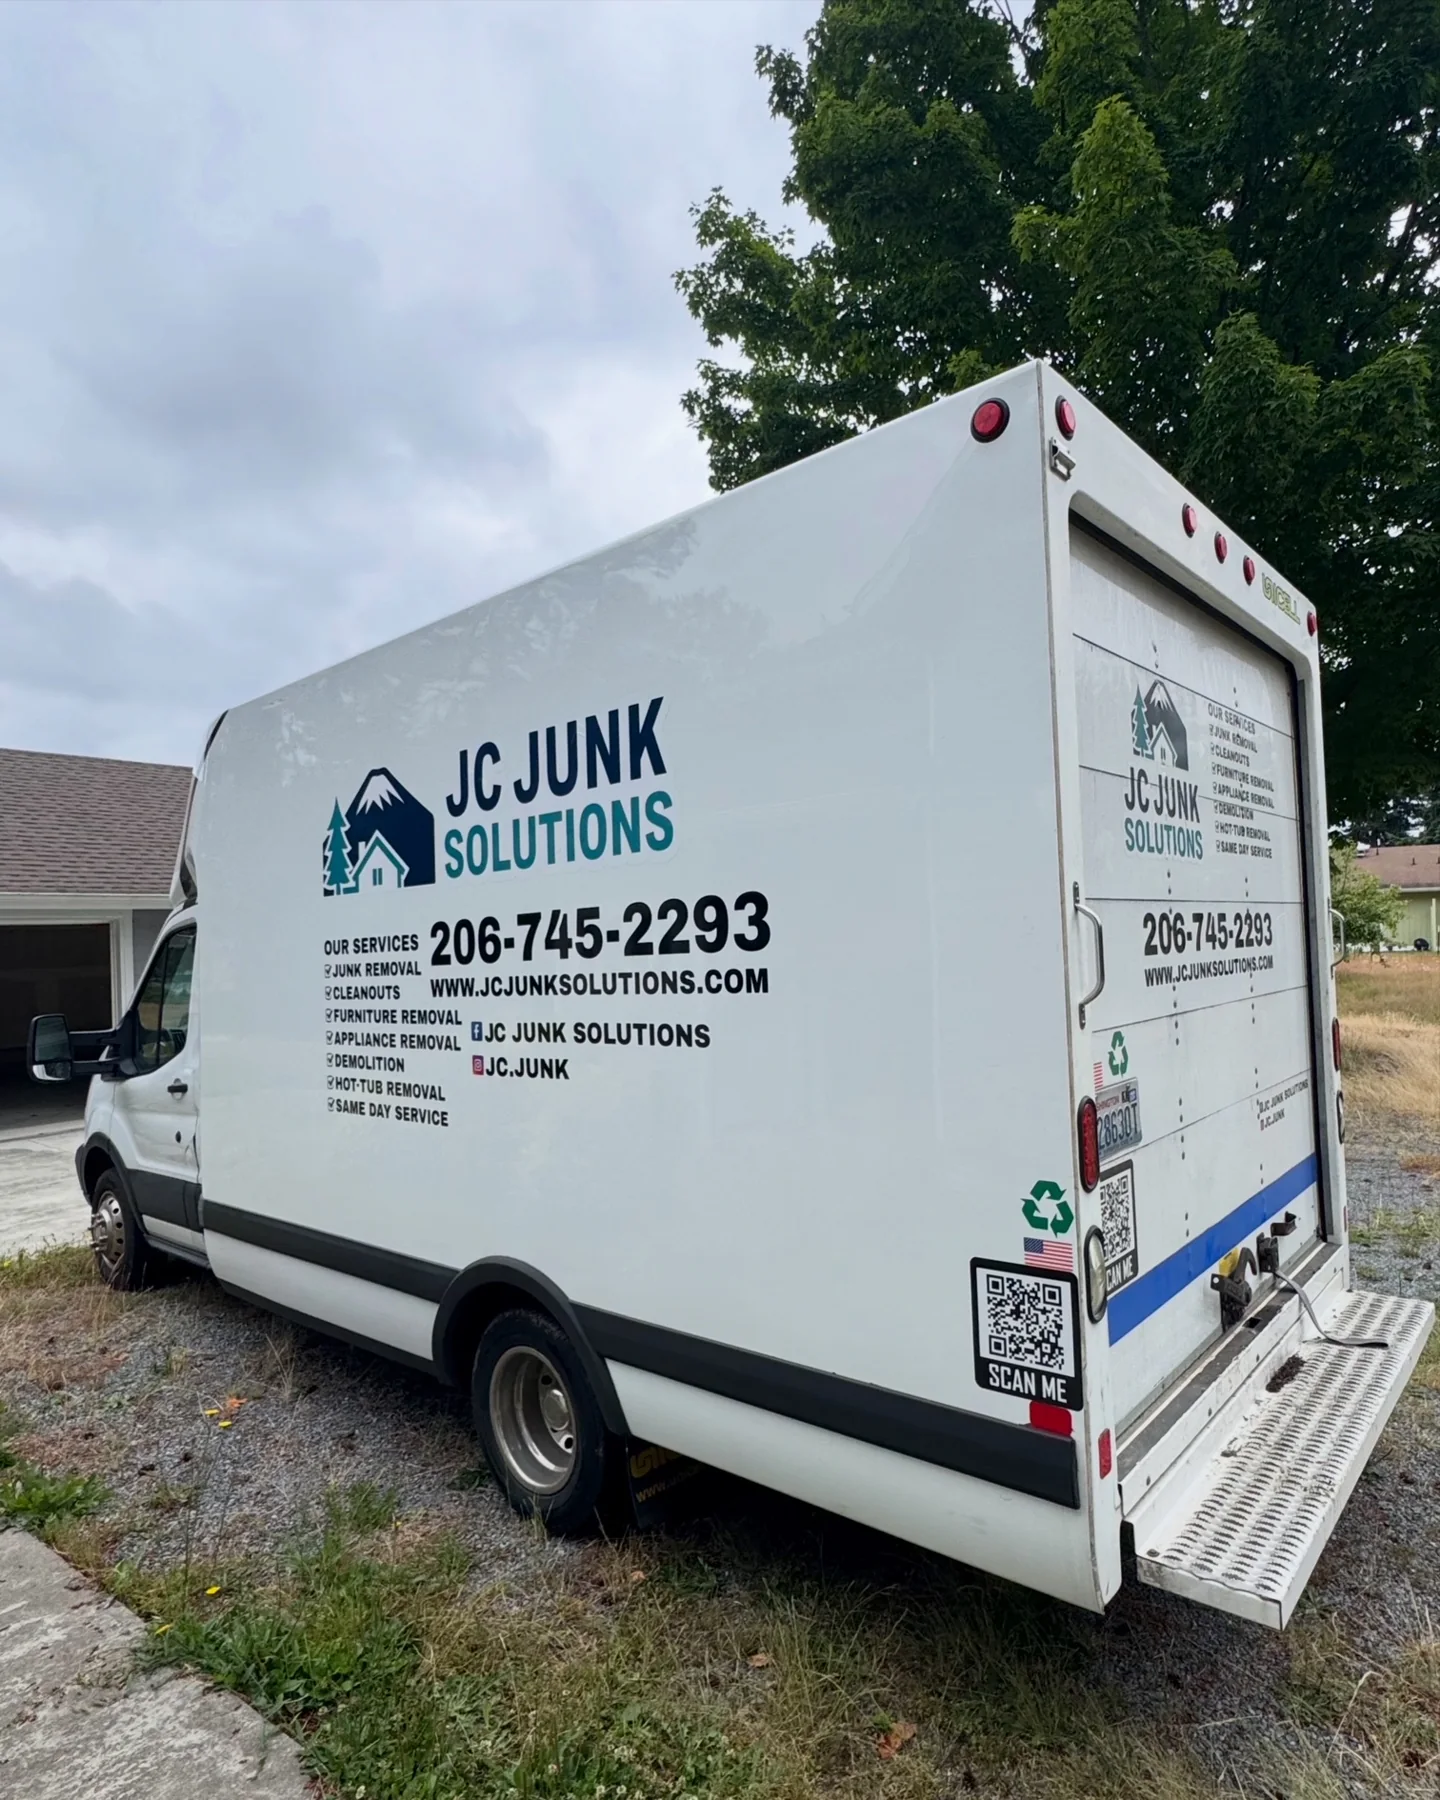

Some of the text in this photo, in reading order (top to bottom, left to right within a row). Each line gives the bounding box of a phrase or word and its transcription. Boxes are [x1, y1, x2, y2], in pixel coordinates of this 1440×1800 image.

[1208, 703, 1256, 734] OUR SERVICES
[1214, 726, 1257, 752] JUNK REMOVAL
[446, 696, 667, 817] JC JUNK
[1215, 745, 1250, 767] CLEANOUTS
[1217, 764, 1274, 792] FURNITURE REMOVAL
[1124, 767, 1201, 823] JC JUNK
[1218, 784, 1274, 809] APPLIANCE REMOVAL
[1219, 803, 1253, 820] DEMOLITION
[444, 791, 674, 878] SOLUTIONS
[1124, 818, 1203, 860] SOLUTIONS
[1246, 827, 1270, 841] REMOVAL
[1221, 841, 1272, 858] SAME DAY SERVICE
[429, 891, 771, 966] 206-745-2293
[1143, 912, 1273, 956] 206-745-2293
[324, 934, 419, 955] OUR SERVICES
[332, 961, 421, 978] JUNK REMOVAL
[430, 968, 768, 997] WWW.JCJUNKSOLUTIONS.COM
[1145, 955, 1273, 987] WWW.JCJUNKSOLUTIONS.COM
[334, 986, 400, 1000] CLEANOUTS
[334, 1009, 462, 1025] FURNITURE REMOVAL
[334, 1032, 461, 1051] APPLIANCE REMOVAL
[485, 1022, 710, 1048] JC JUNK SOLUTIONS
[335, 1054, 405, 1072] DEMOLITION
[486, 1057, 569, 1079] JC.JUNK
[335, 1077, 446, 1100] HOT-TUB REMOVAL
[336, 1099, 449, 1127] SAME DAY SERVICE
[989, 1363, 1067, 1403] SCAN ME
